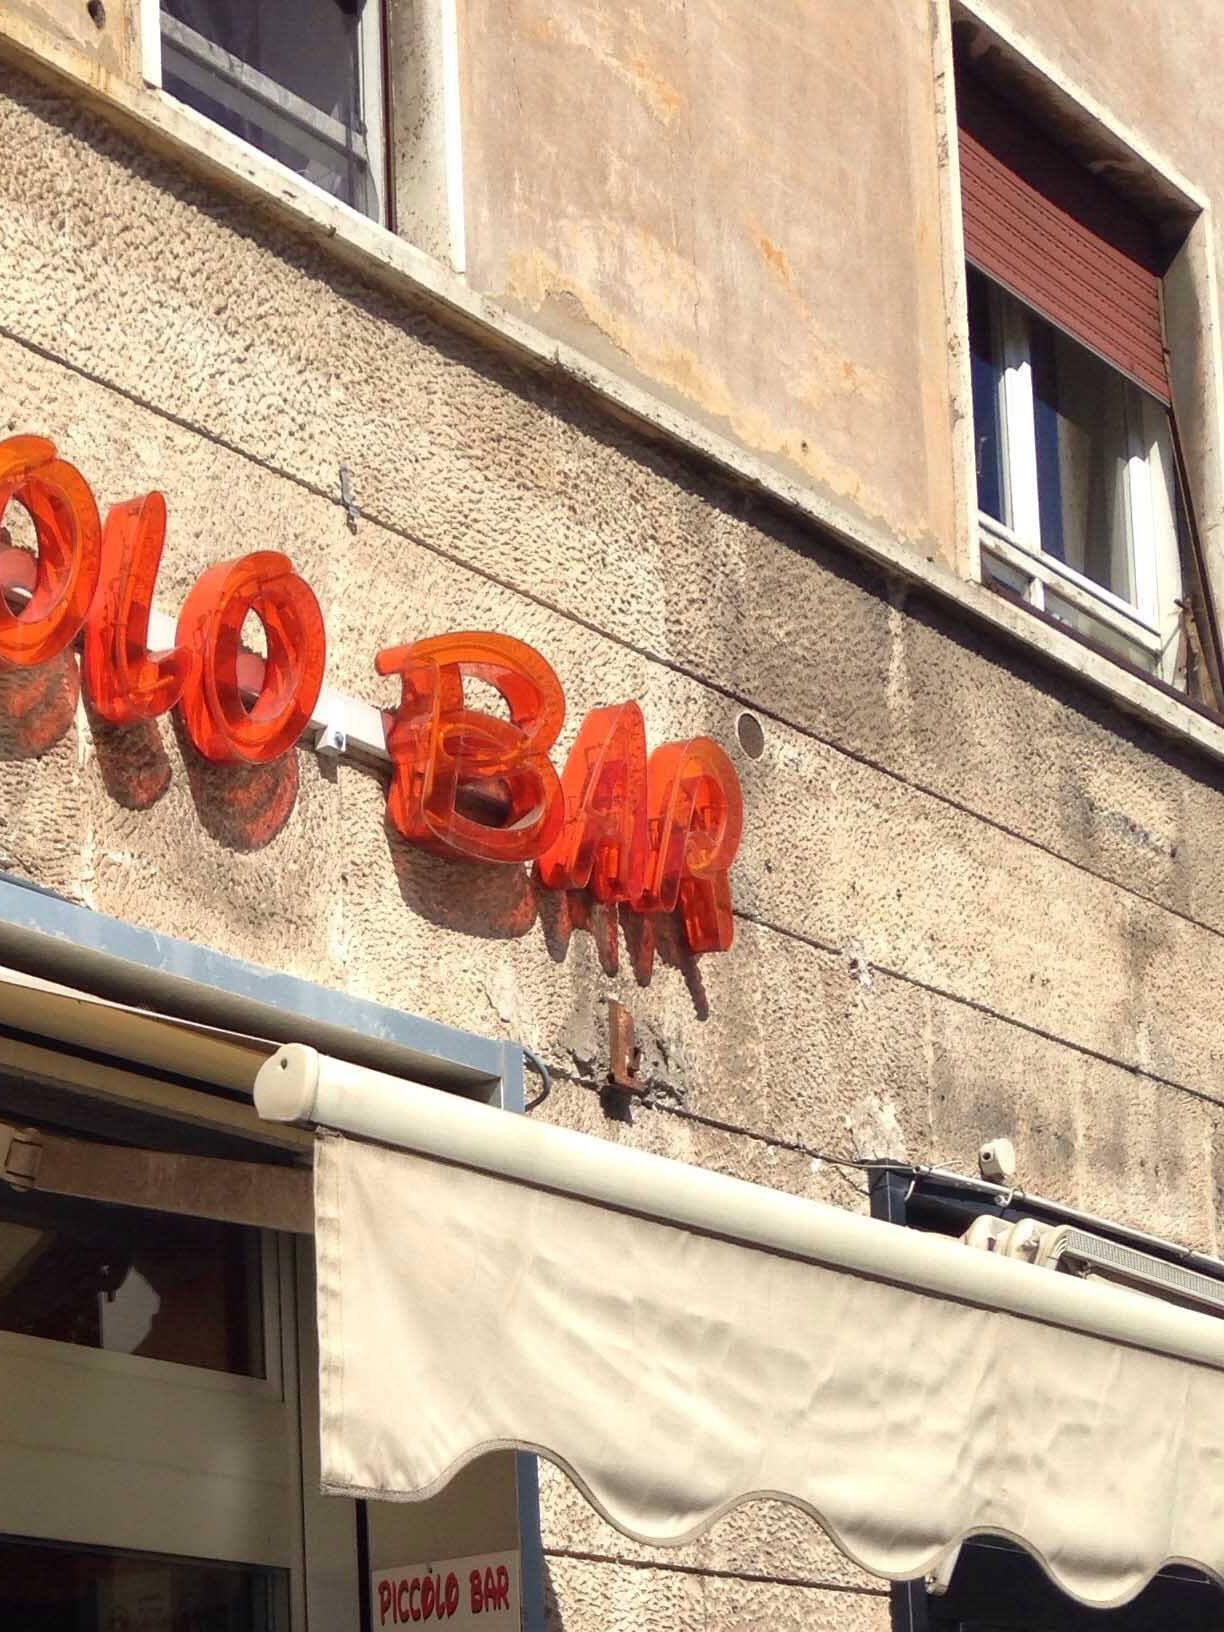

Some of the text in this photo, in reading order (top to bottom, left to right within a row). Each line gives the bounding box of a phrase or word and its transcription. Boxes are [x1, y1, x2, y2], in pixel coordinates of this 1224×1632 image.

[375, 630, 746, 955] BAR
[378, 1565, 511, 1626] PICCOLO BAR
